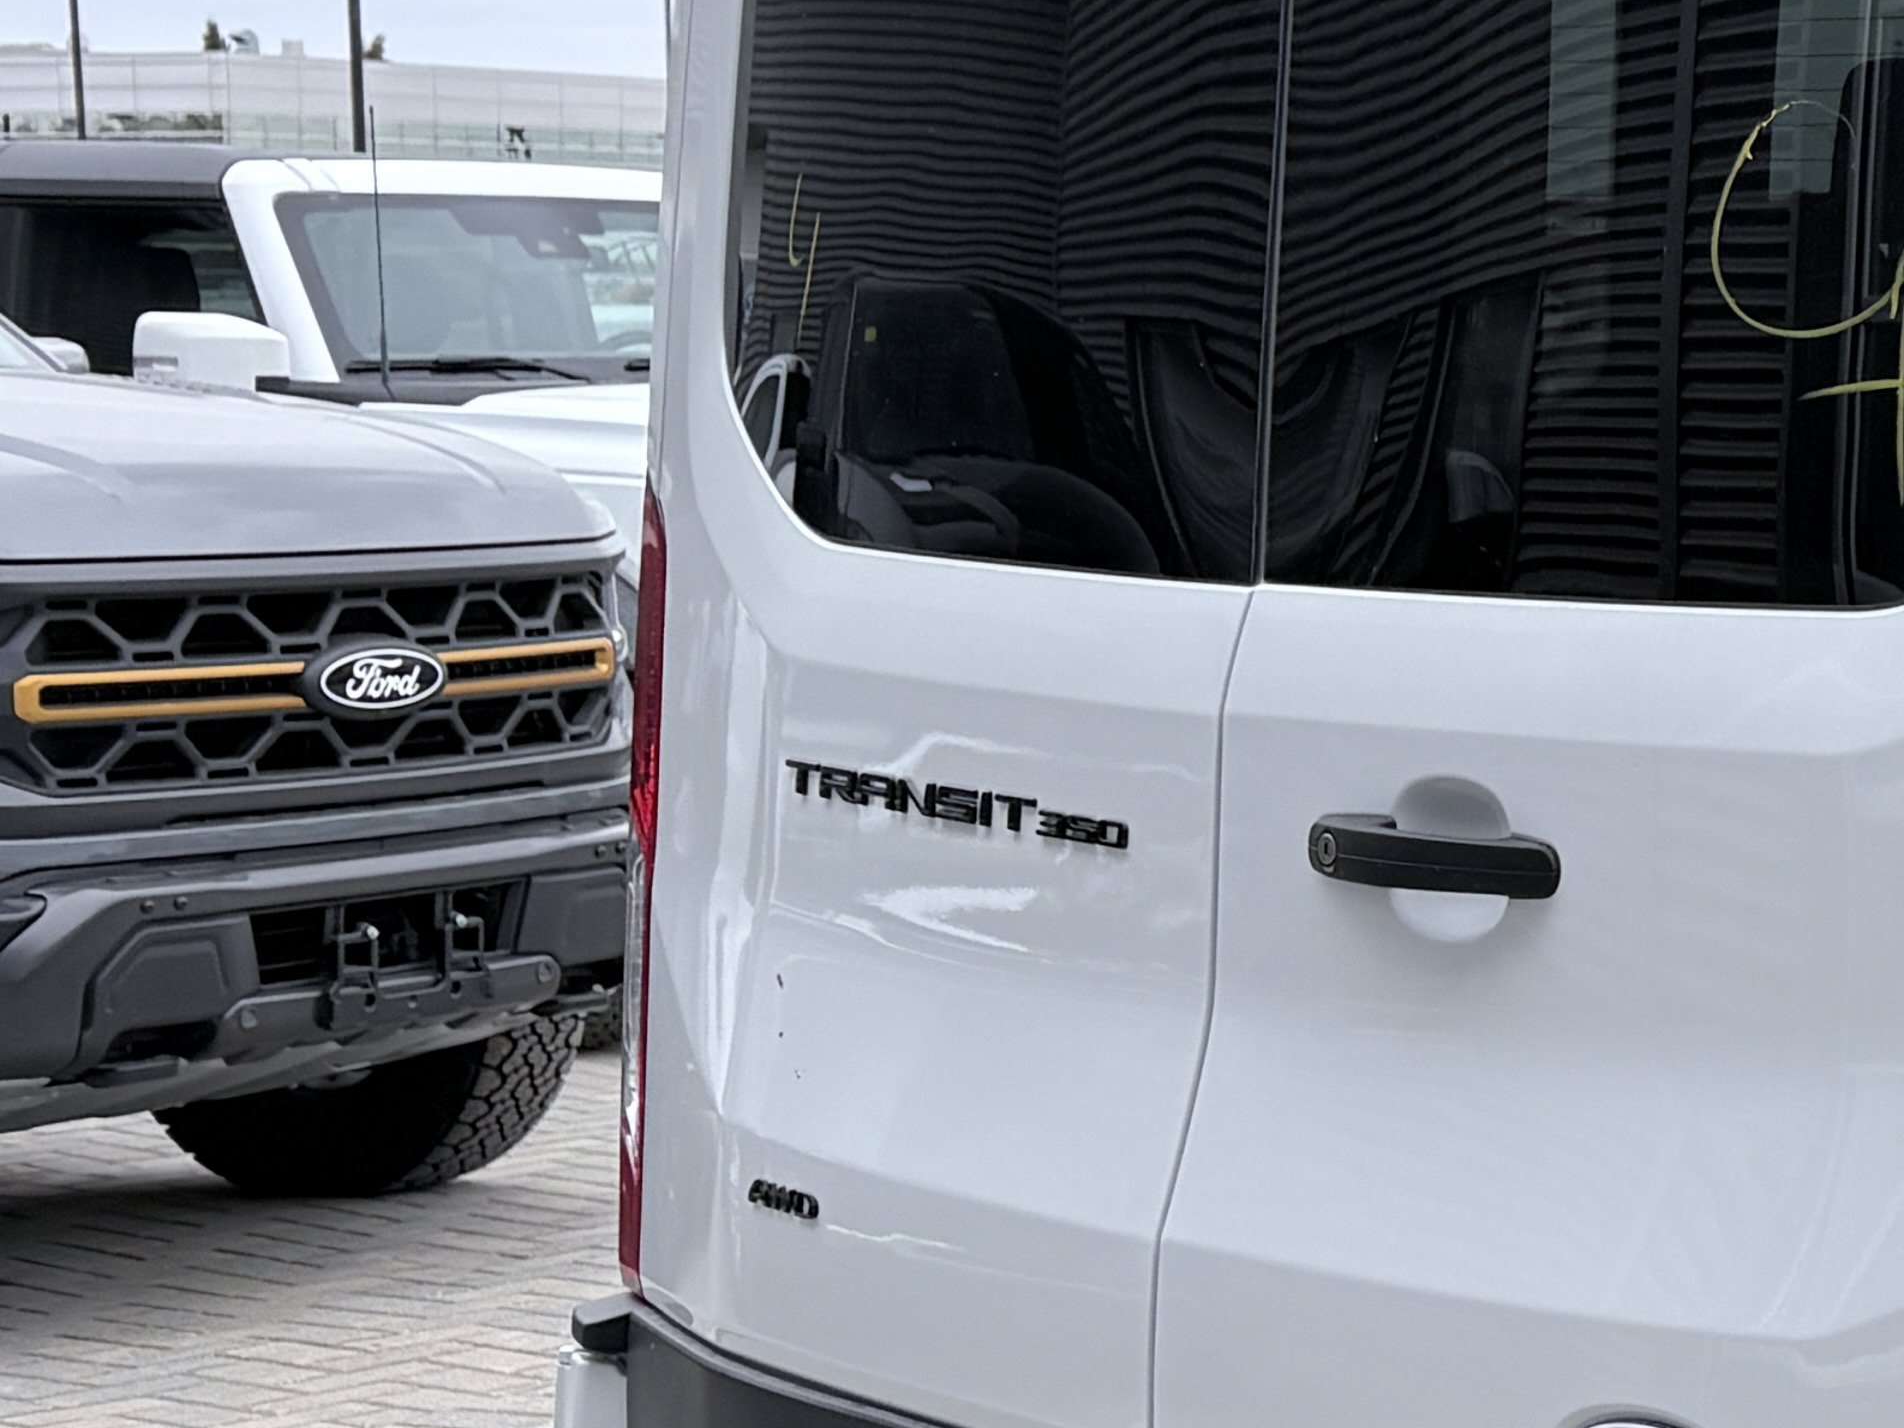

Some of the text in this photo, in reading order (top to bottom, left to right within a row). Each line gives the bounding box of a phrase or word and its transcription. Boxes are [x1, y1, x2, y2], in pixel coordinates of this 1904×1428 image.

[345, 658, 421, 699] Ford
[785, 759, 1129, 849] TRANSIT 350
[748, 1178, 819, 1220] AWD
